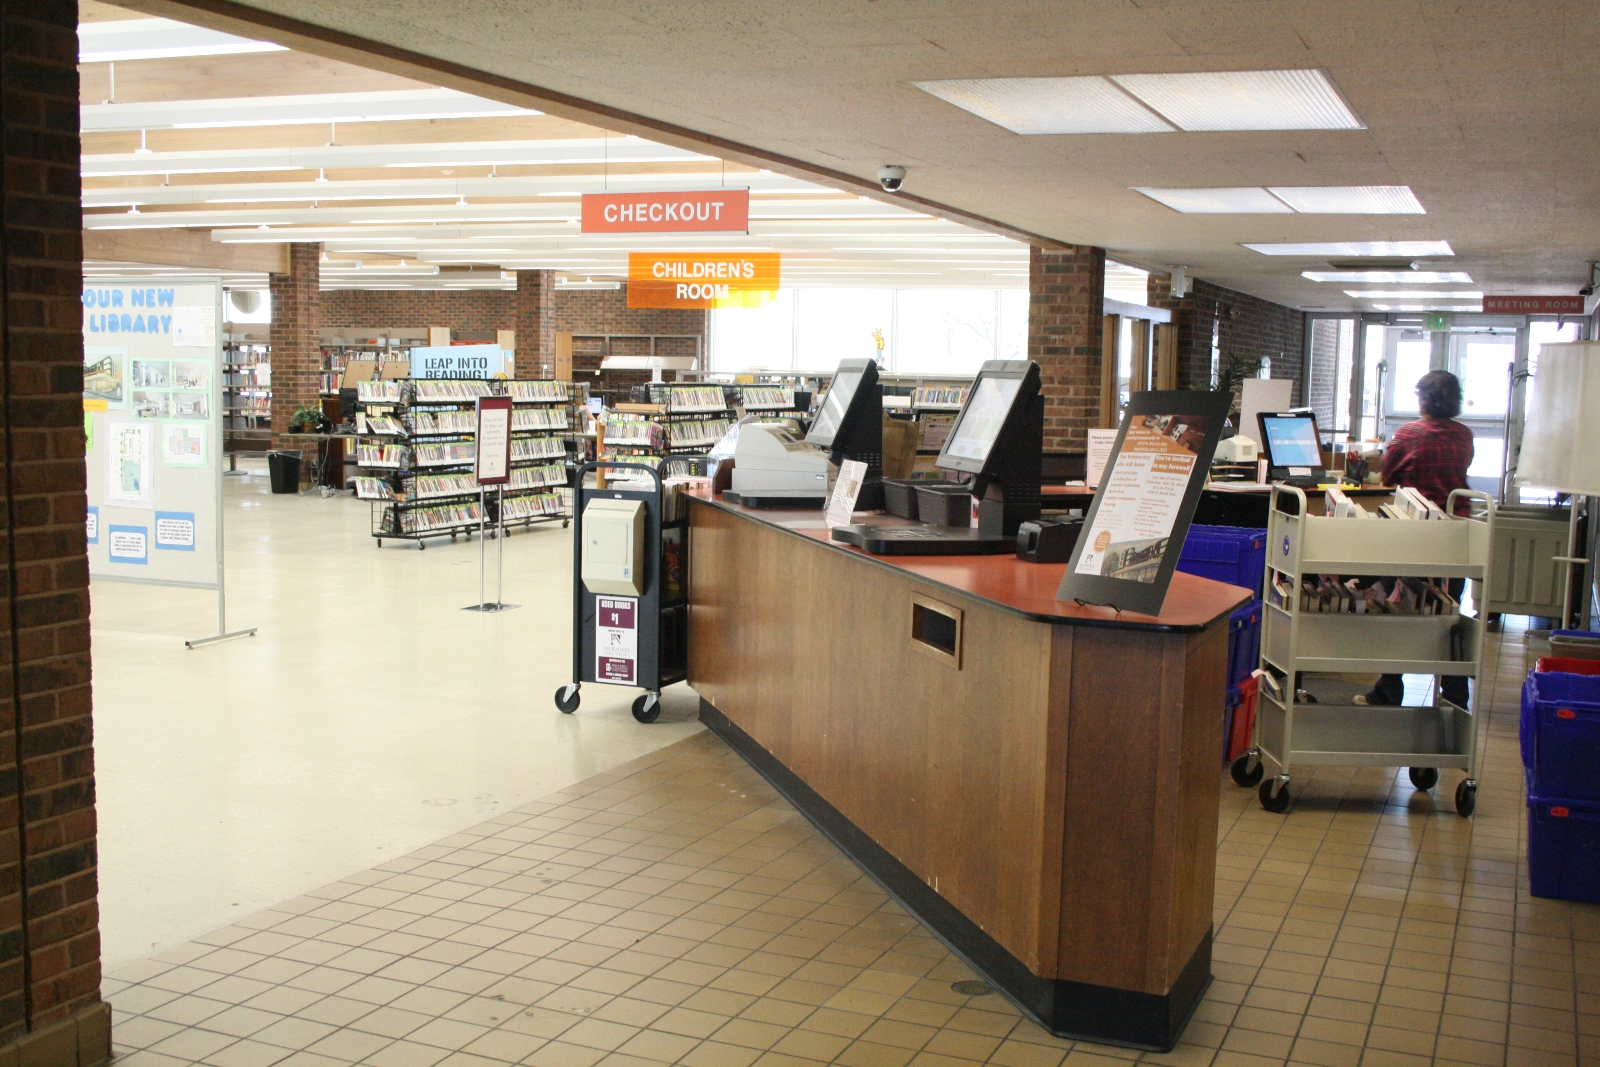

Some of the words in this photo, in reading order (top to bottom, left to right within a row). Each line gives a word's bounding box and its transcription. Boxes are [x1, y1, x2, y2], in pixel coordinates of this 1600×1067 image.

[604, 202, 724, 222] CHECKOUT
[652, 259, 754, 278] CHILDREN'S
[83, 289, 123, 308] OUR
[131, 288, 174, 307] NEW
[676, 283, 729, 299] ROOM
[90, 314, 172, 334] LIBRARY
[1427, 315, 1447, 330] EXIT
[425, 358, 453, 369] LEAP
[458, 357, 488, 369] INTO
[425, 370, 488, 379] READING!
[615, 601, 631, 609] BOOKS
[612, 613, 618, 624] $1
